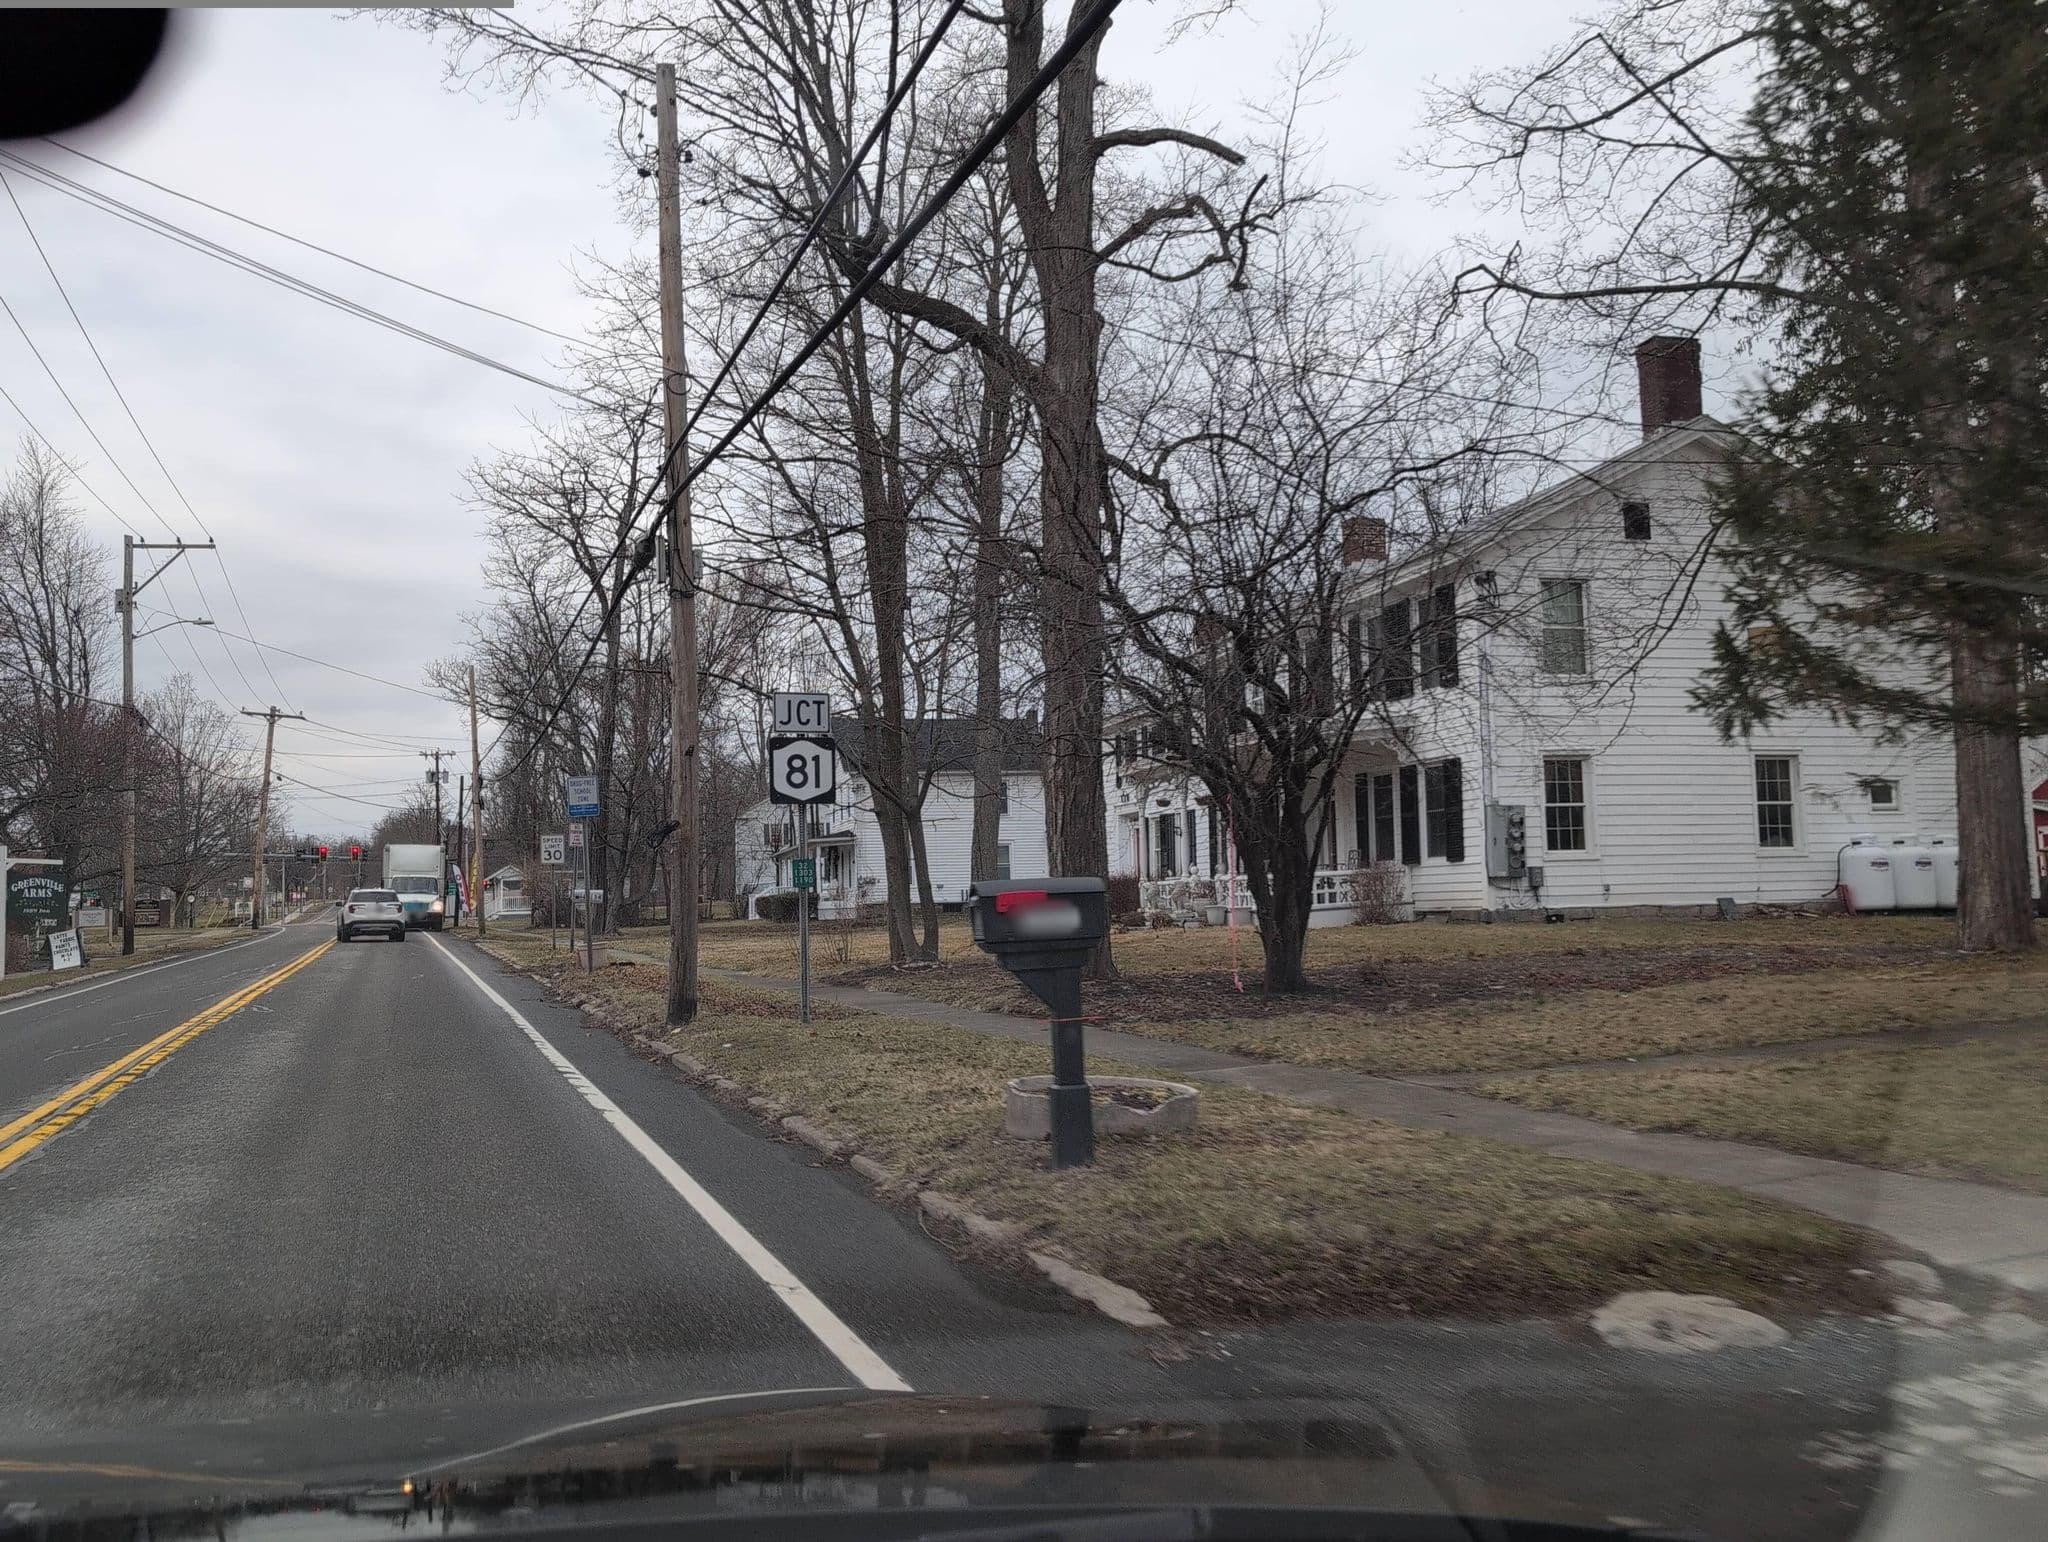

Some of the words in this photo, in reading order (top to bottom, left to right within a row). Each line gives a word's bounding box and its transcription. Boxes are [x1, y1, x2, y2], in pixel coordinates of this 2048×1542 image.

[779, 700, 825, 726] JCT
[786, 754, 821, 789] 81
[544, 850, 562, 860] 30
[11, 877, 64, 892] GREENVILLE
[22, 888, 52, 898] ARMS
